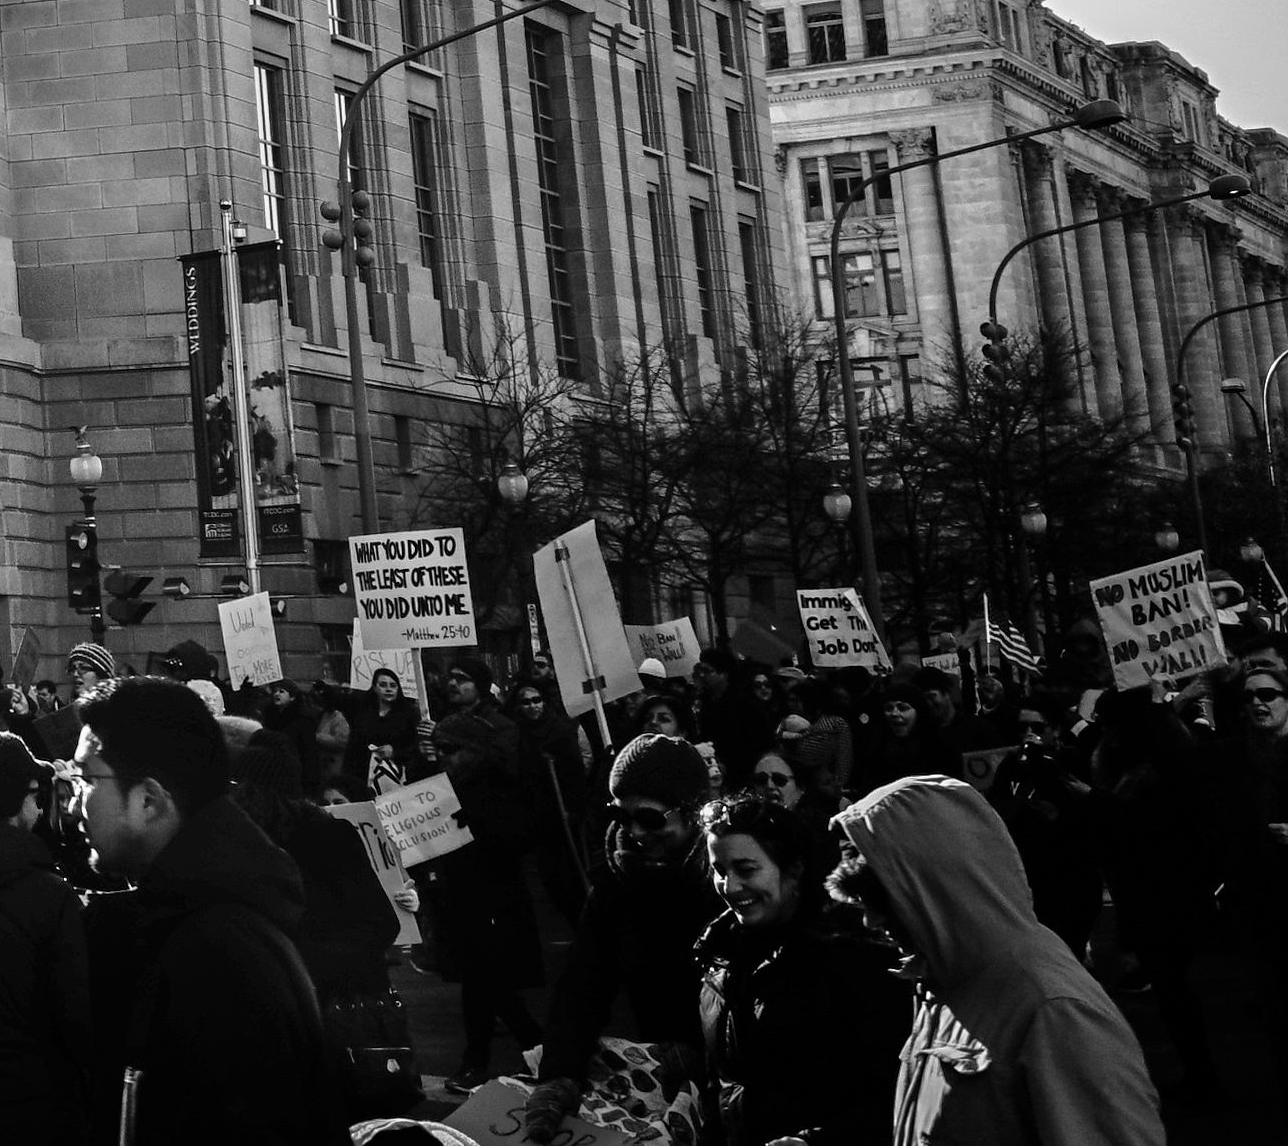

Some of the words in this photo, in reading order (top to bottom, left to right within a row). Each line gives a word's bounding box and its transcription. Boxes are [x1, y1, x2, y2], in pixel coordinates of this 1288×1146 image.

[185, 265, 200, 354] WEDDINGS
[271, 523, 289, 534] GSA
[354, 541, 382, 563] WHAT
[381, 538, 405, 560] YOU
[407, 538, 434, 560] DID
[434, 536, 456, 557] TO
[356, 570, 377, 591] THE
[376, 568, 409, 590] LEAST
[411, 566, 427, 587] OF
[426, 566, 467, 587] THESE
[1095, 584, 1124, 607] NO
[1128, 560, 1203, 599] MUSLIM
[360, 598, 383, 619] YOU
[386, 597, 410, 619] DID
[411, 595, 443, 617] UNTO
[444, 594, 470, 616] ME
[1131, 589, 1190, 626] BAN!
[807, 615, 839, 631] Get
[817, 638, 848, 655] Job
[1113, 639, 1139, 665] NO
[1147, 616, 1214, 652] BORDER
[415, 791, 437, 805] TO
[384, 807, 441, 837] ELIGIOUS
[399, 822, 450, 851] CLUSION!
